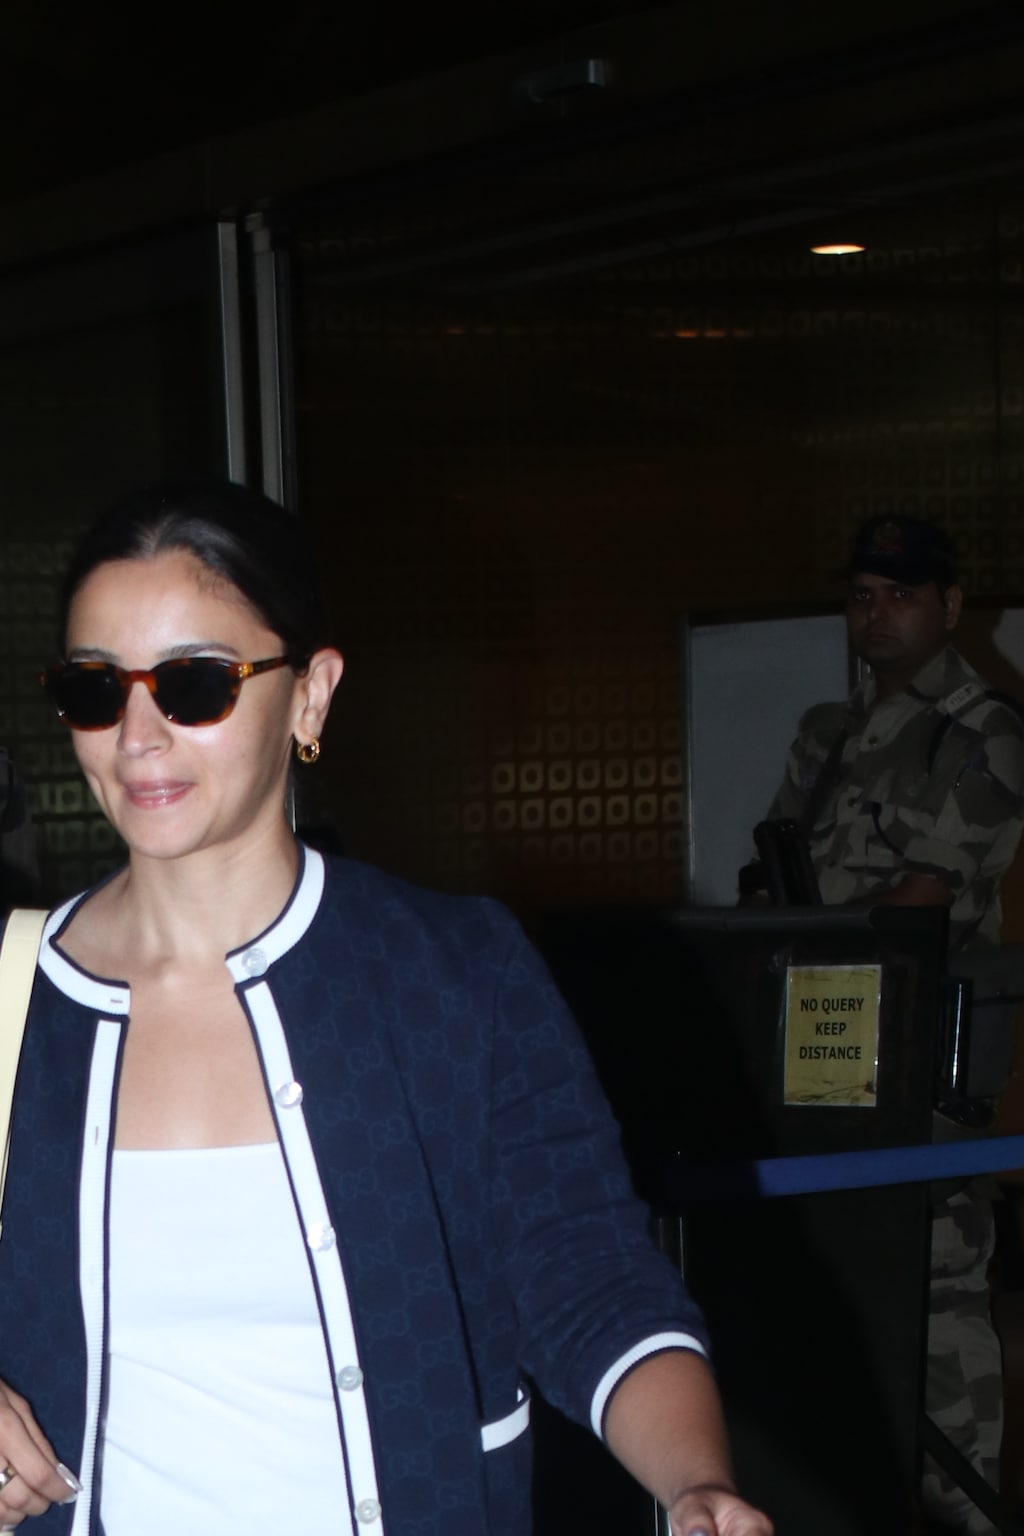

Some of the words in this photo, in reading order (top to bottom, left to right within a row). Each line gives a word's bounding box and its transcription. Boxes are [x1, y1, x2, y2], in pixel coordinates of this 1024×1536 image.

[800, 999, 818, 1012] NO
[822, 999, 864, 1015] QUERY
[815, 1023, 847, 1036] KEEP
[799, 1047, 862, 1060] DISTANCE
